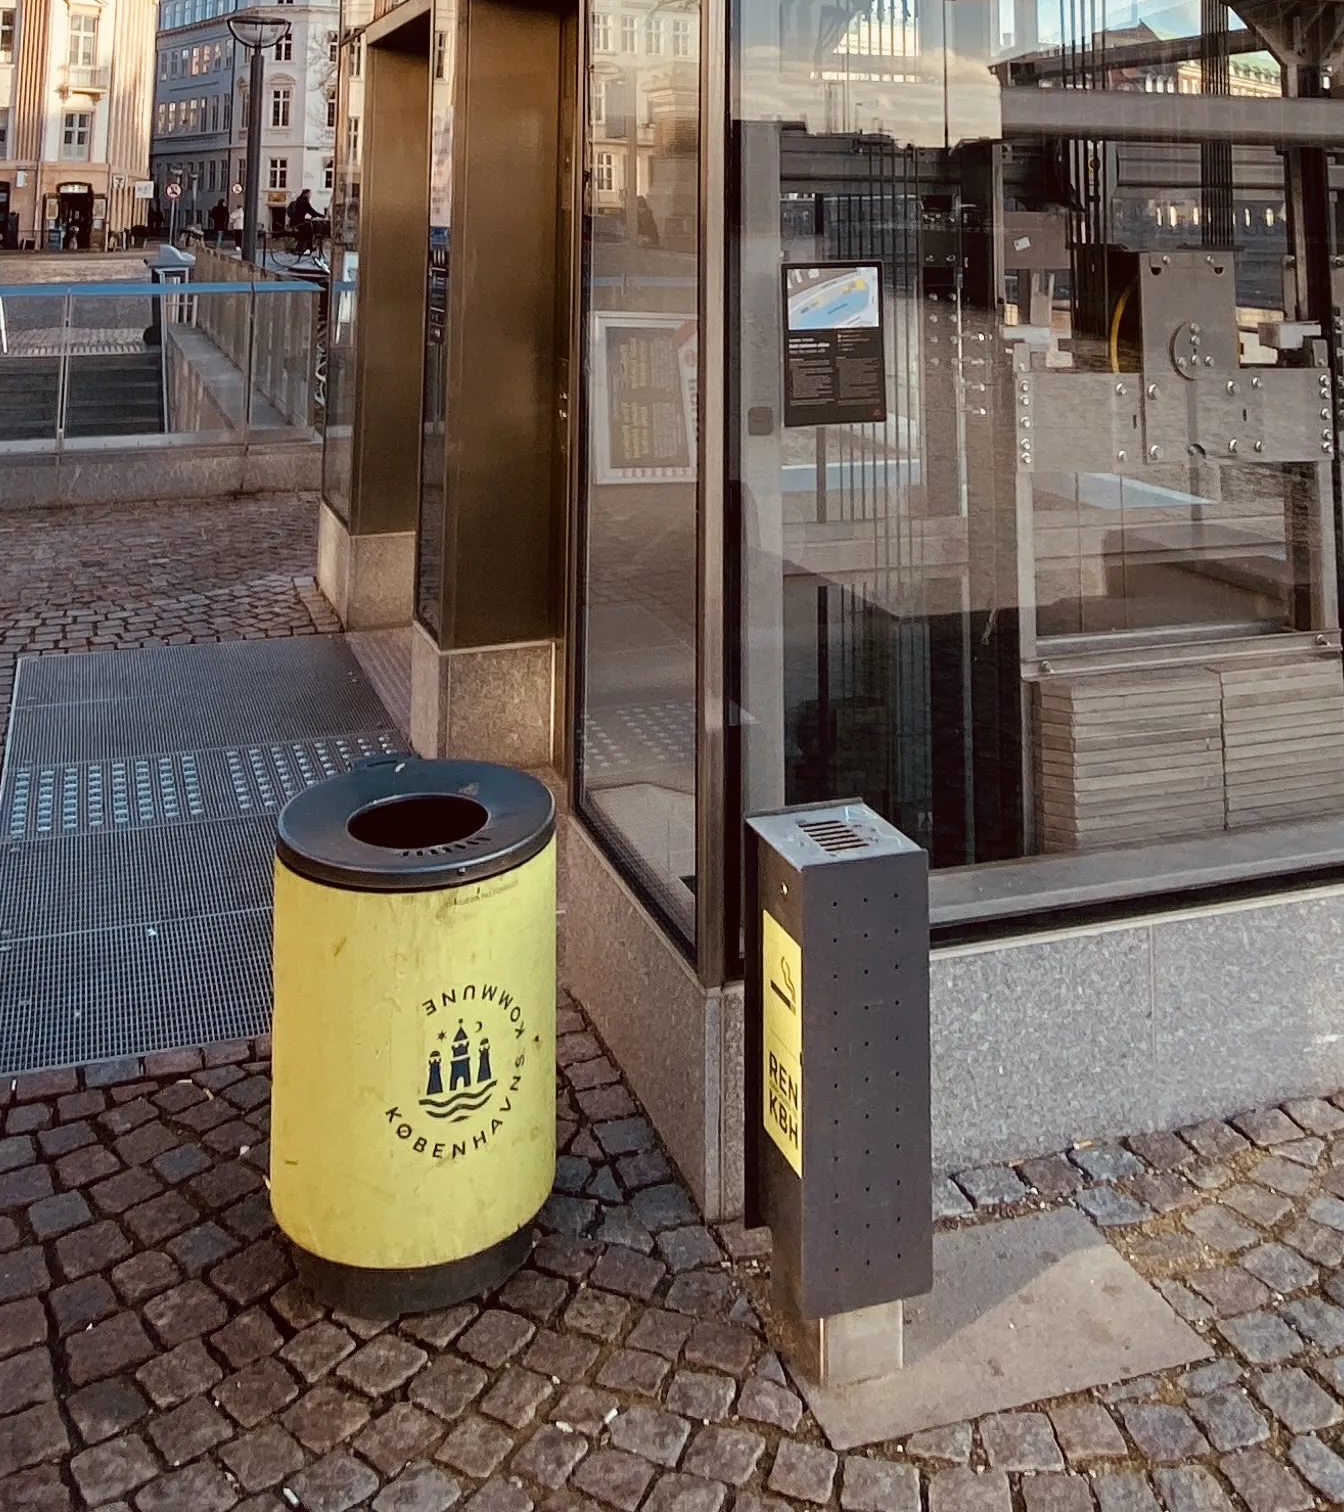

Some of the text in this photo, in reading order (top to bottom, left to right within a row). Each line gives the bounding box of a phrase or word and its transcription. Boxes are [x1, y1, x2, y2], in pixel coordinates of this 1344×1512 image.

[422, 983, 525, 1040] KOMMUNE
[385, 1054, 525, 1159] KØBENHAVNS
[769, 1050, 798, 1110] REN
[769, 1087, 798, 1150] KBH
